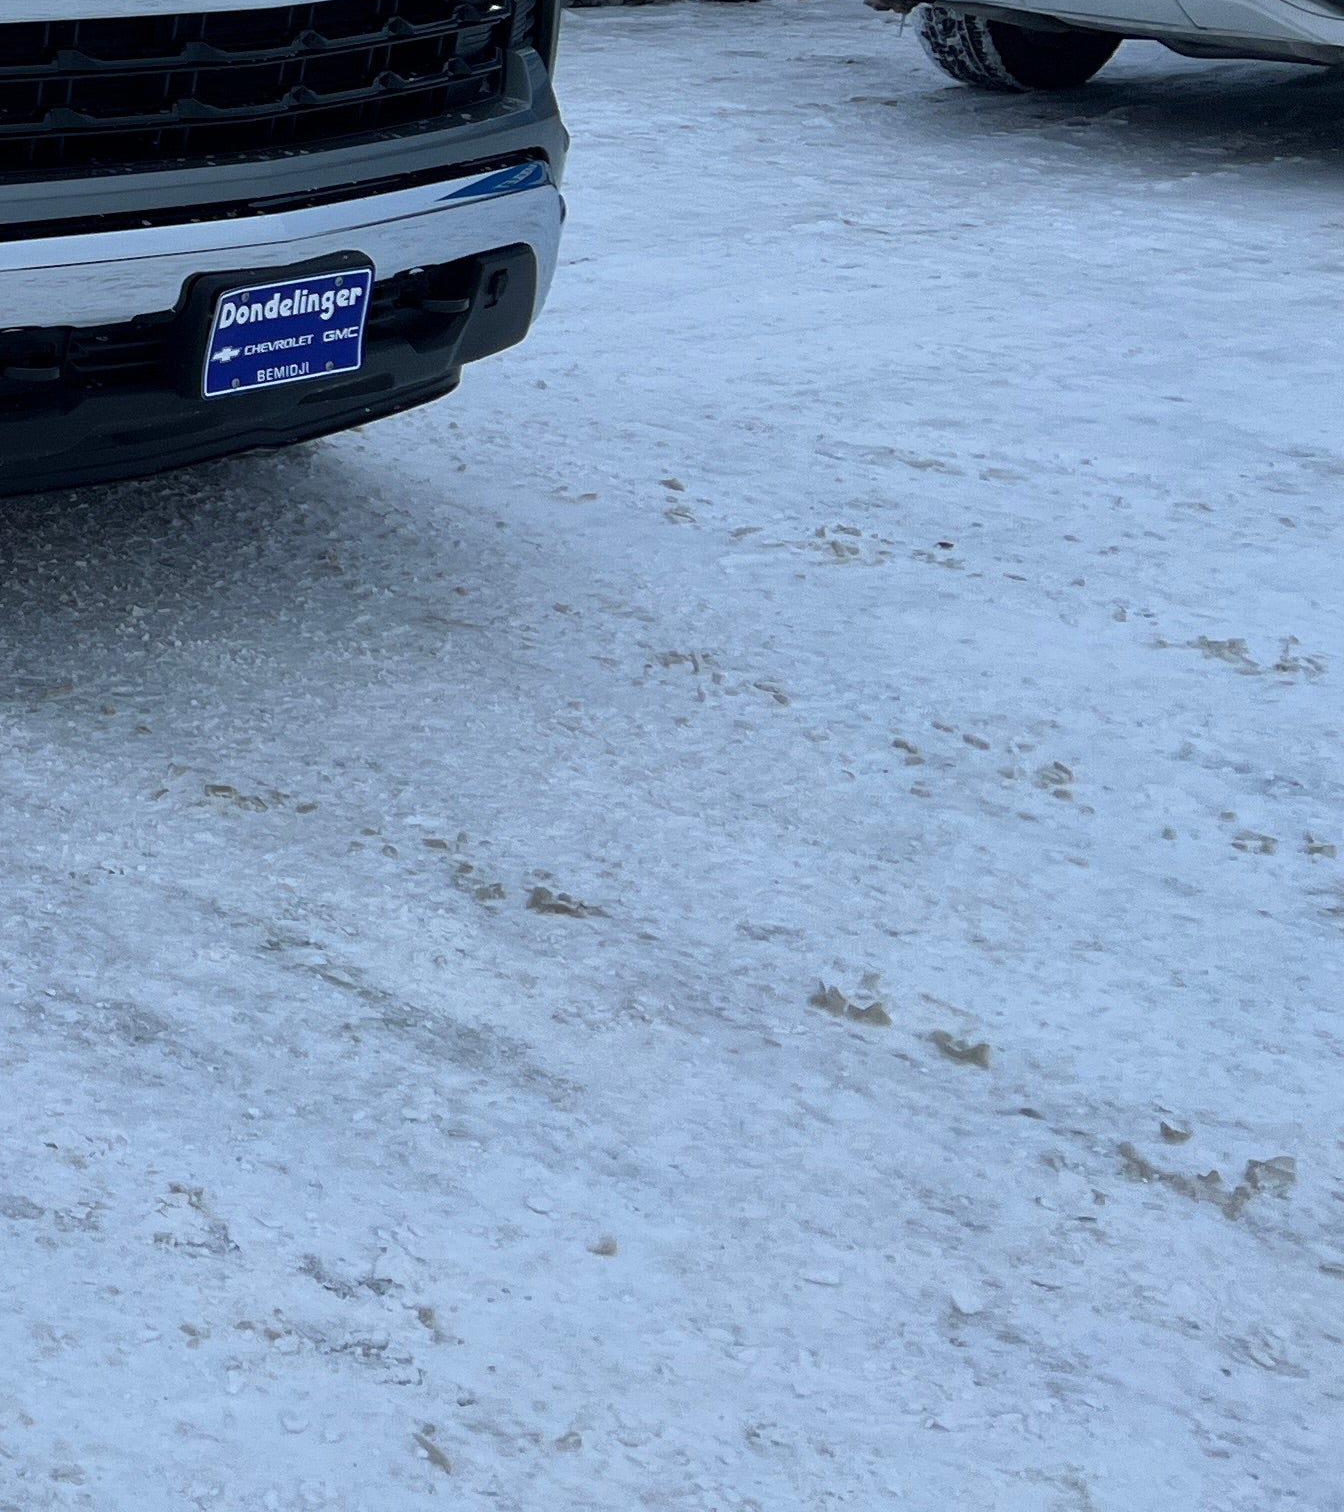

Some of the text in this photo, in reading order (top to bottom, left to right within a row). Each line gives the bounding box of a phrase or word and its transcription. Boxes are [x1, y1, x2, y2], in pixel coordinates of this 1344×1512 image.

[218, 287, 362, 329] Dondelinger
[244, 326, 360, 356] CHEVROLET GMC
[257, 361, 310, 382] BEMIDJI
